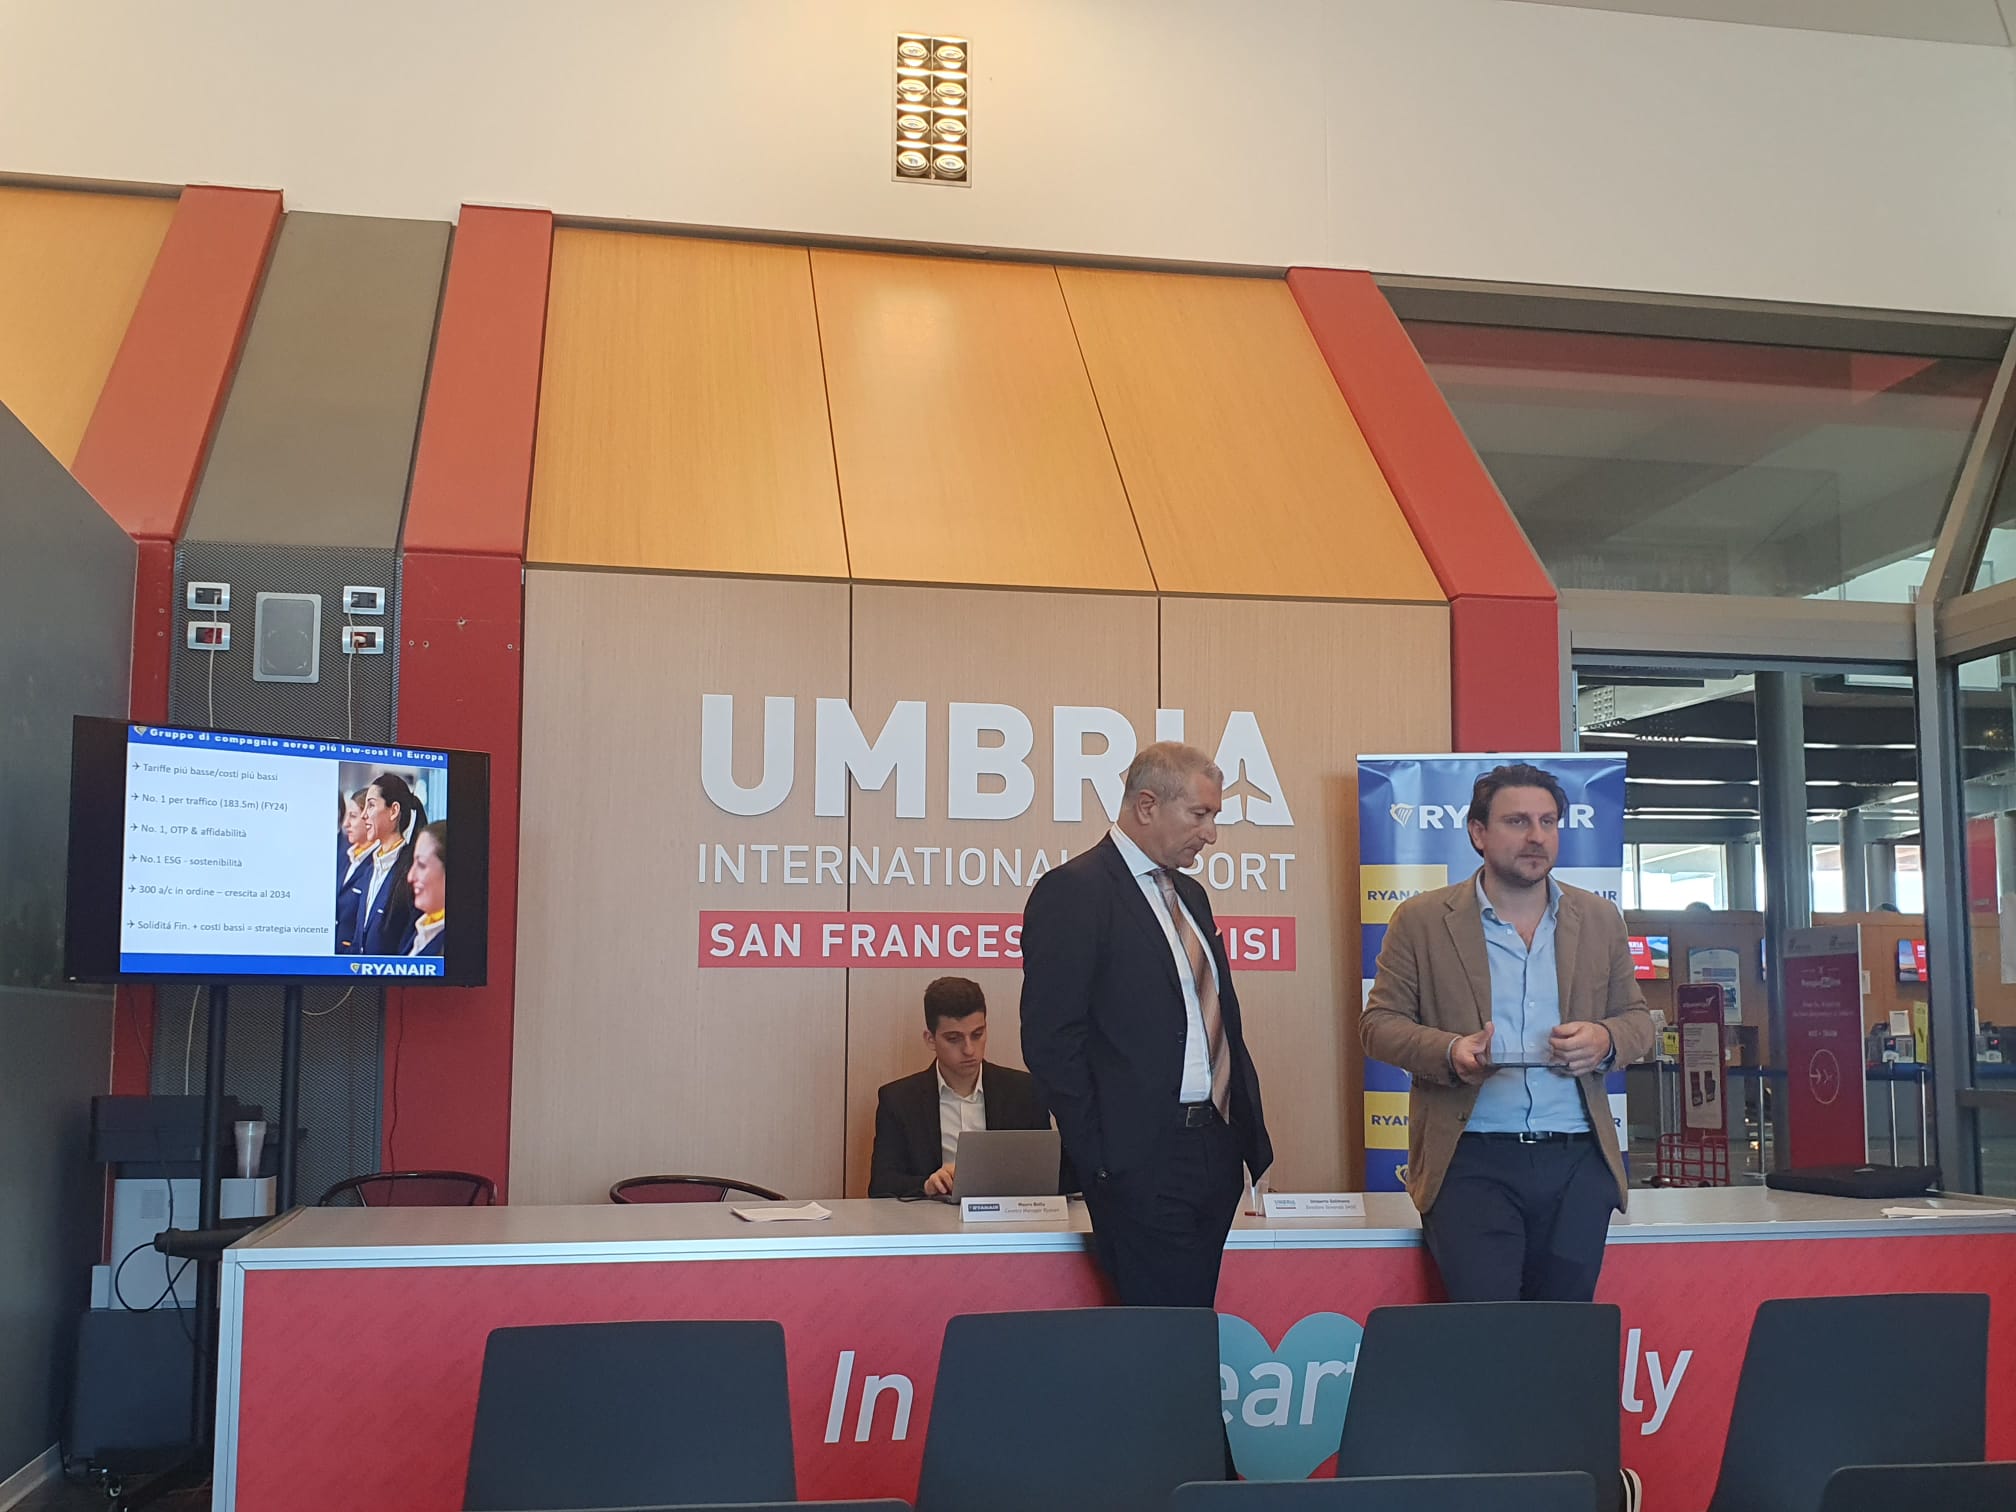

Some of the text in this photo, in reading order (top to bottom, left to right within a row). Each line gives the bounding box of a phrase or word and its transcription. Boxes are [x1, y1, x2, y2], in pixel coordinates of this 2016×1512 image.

[150, 728, 194, 740] Gruppo
[199, 730, 210, 741] di
[214, 735, 278, 748] compagnie
[283, 741, 315, 750] aeree
[341, 745, 388, 757] low-cost
[393, 748, 403, 758] in
[407, 751, 444, 762] Europa
[700, 694, 1295, 826] UMBRA
[143, 763, 171, 773] Tariffe
[190, 767, 239, 778] basse/costi
[257, 772, 278, 781] bassi
[142, 793, 288, 813] No. 1 per traffico (183.5m) (FY24)
[141, 824, 157, 833] No.
[170, 826, 189, 835] OTP
[191, 827, 198, 835] &
[140, 855, 161, 864] No.1
[164, 855, 182, 865] ESG
[139, 885, 156, 894] 300
[158, 886, 173, 895] a/c
[175, 887, 184, 895] in
[186, 887, 214, 897] ordine
[225, 888, 258, 898] crescita
[260, 889, 268, 898] al
[270, 890, 291, 899] 2034
[174, 921, 191, 930] Fin.
[200, 923, 221, 931] costi
[223, 923, 245, 932] bassi
[255, 924, 291, 934] strategia
[293, 925, 329, 934] vincente
[710, 922, 801, 958] SAN
[361, 963, 437, 976] RYANAIR
[824, 1350, 914, 1443] In
